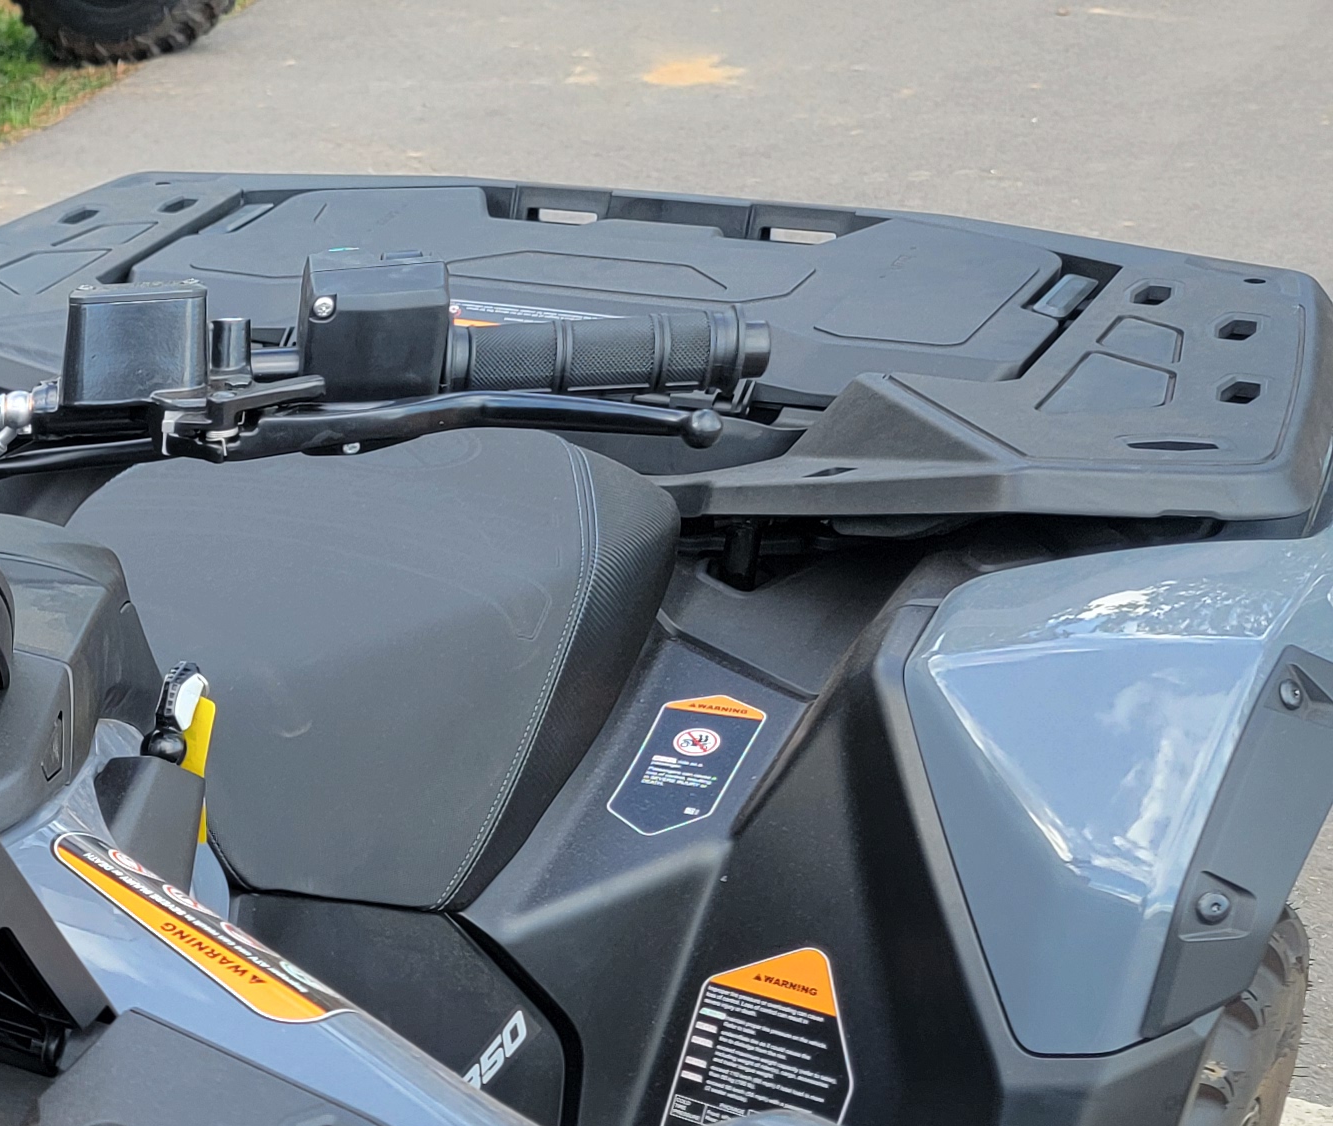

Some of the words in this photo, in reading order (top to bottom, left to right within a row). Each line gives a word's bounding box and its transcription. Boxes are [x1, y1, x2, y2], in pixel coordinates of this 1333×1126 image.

[697, 703, 748, 715] WARNING
[161, 922, 248, 977] WARNING
[763, 974, 818, 996] WARNING
